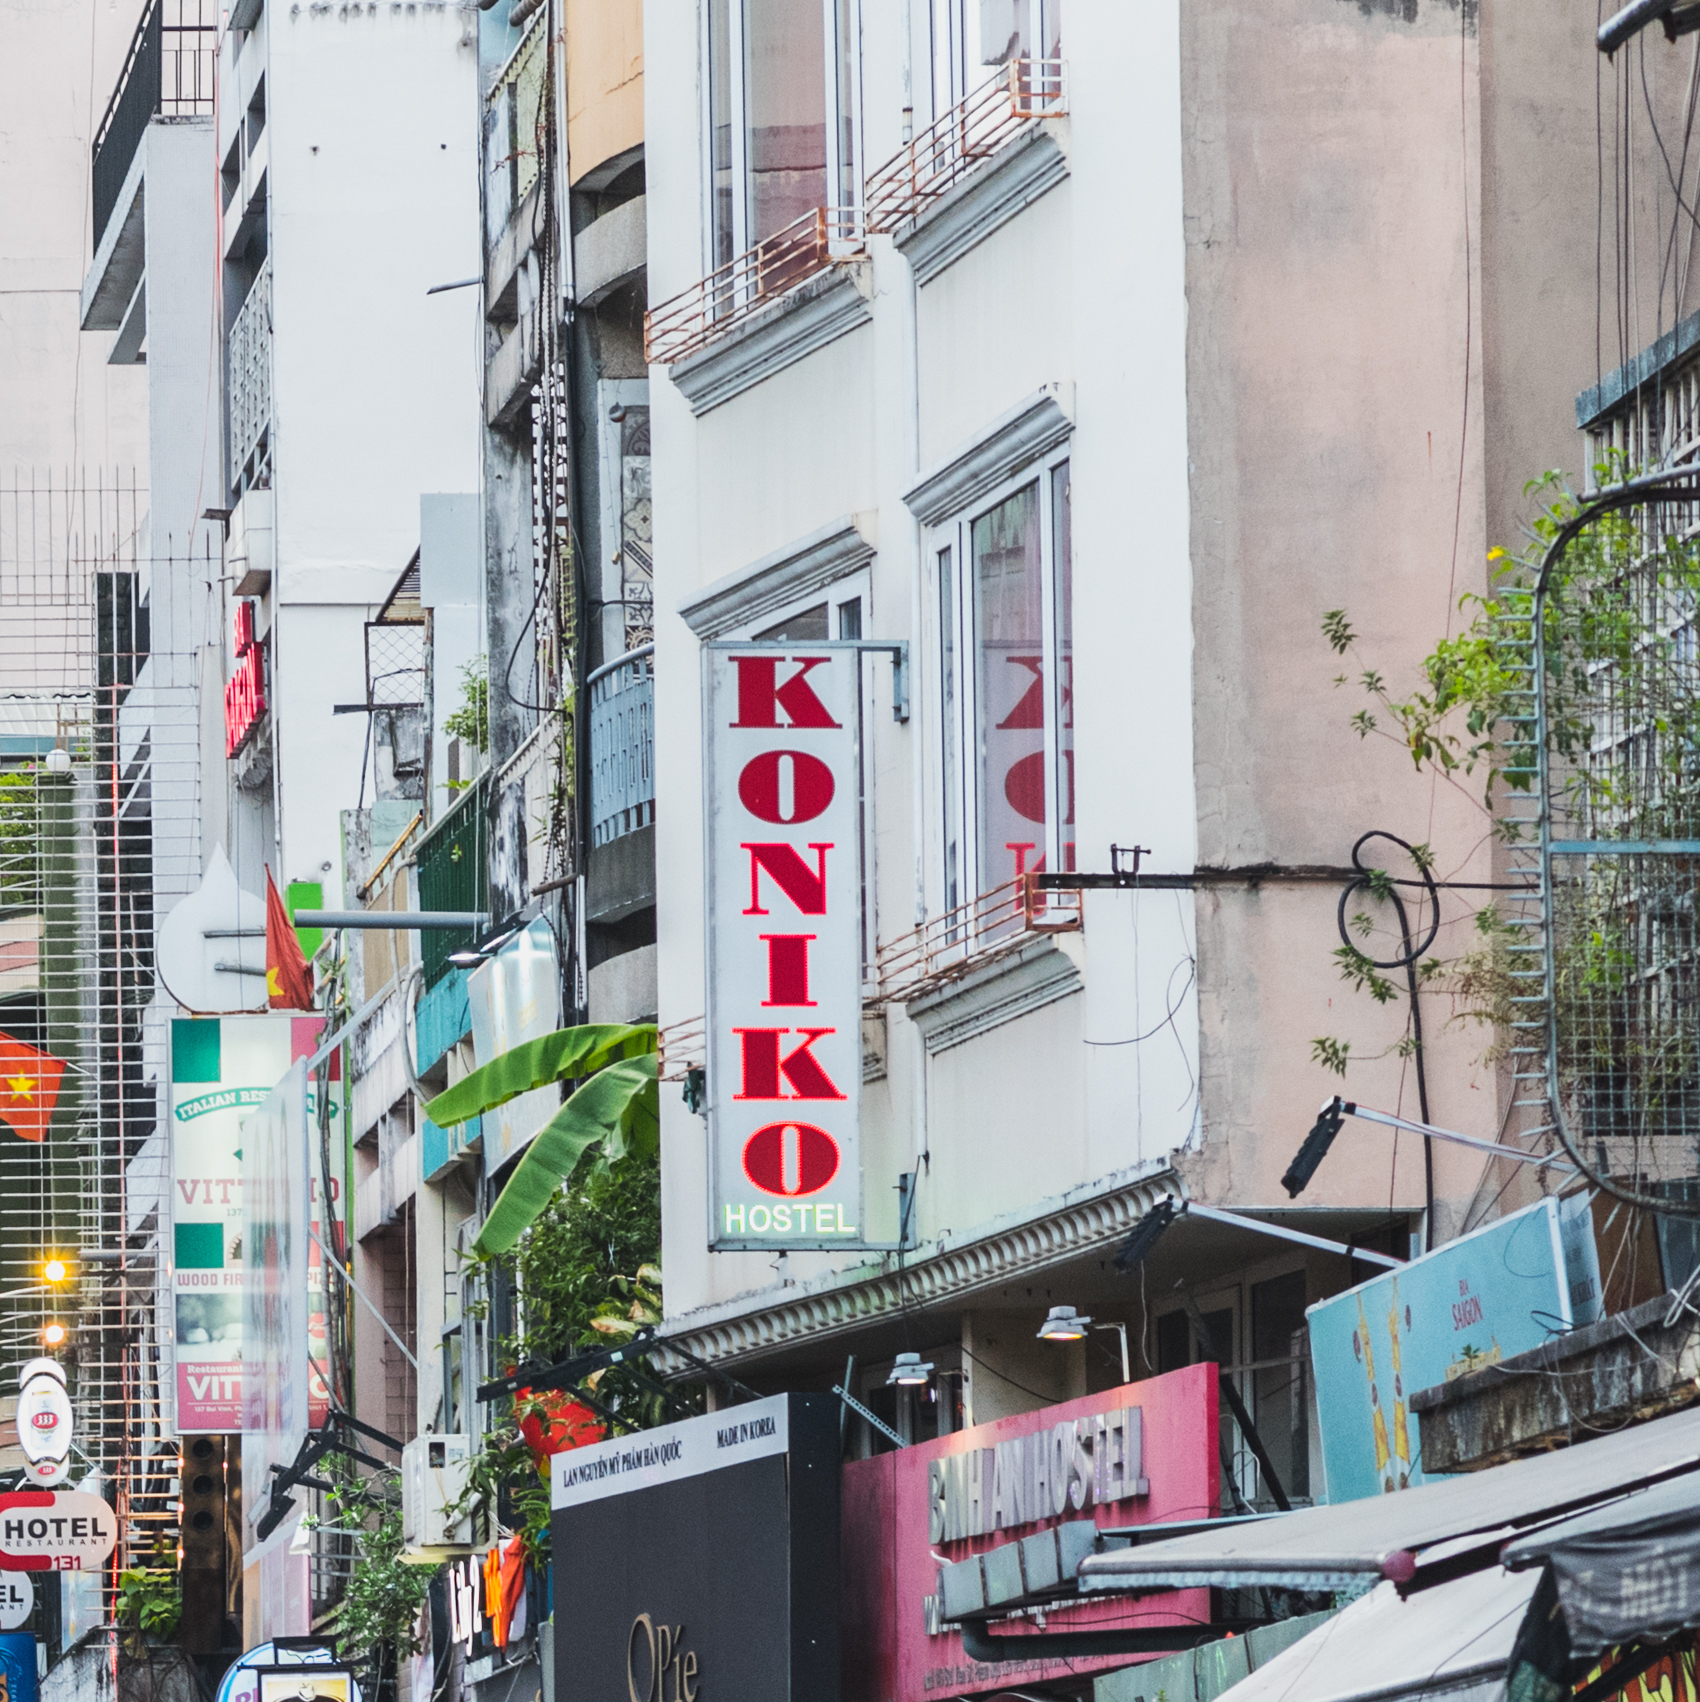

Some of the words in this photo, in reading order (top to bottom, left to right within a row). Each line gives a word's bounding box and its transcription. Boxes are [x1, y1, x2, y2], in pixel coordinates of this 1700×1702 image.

[728, 655, 847, 1198] KONIKO
[178, 1091, 236, 1120] ITALIAN
[725, 1204, 856, 1233] HOSTEL
[178, 1273, 218, 1286] WOOD
[1458, 1279, 1469, 1297] BIA
[1452, 1294, 1484, 1332] SAIGON
[37, 1414, 54, 1425] 333
[717, 1427, 739, 1449] MADE
[739, 1426, 748, 1444] IN
[749, 1416, 776, 1440] KOREA
[563, 1469, 578, 1488] LAN
[643, 1441, 660, 1468] HÀN
[1030, 1405, 1150, 1521] HOSTEL
[4, 1517, 108, 1540] HOTEL
[5, 1538, 108, 1546] RESTAURANT
[53, 1555, 82, 1571] 131
